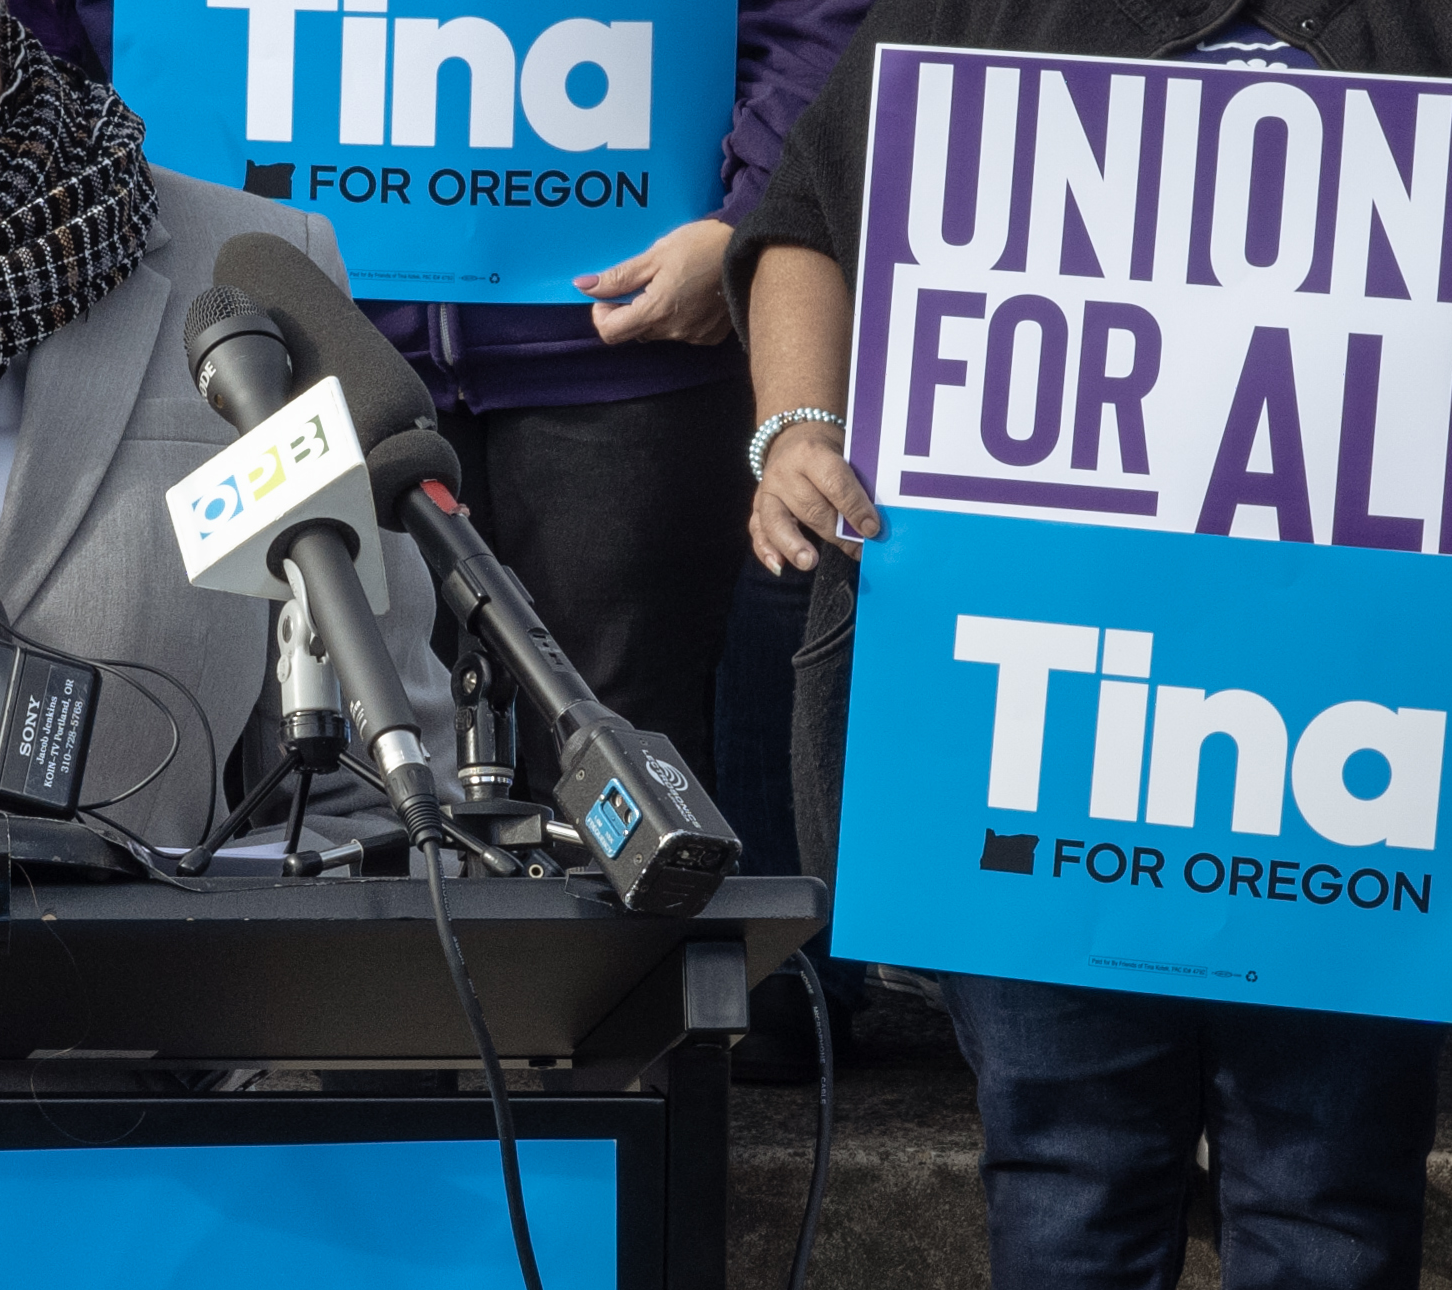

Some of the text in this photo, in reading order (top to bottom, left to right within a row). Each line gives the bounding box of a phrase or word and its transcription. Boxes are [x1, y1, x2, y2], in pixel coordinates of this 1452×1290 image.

[311, 166, 648, 207] FOR OREGON
[904, 287, 1163, 475] FOR
[191, 414, 330, 540] OPB
[19, 695, 41, 757] SONY
[35, 696, 58, 765] Jacob Jenkins
[54, 698, 72, 743] Portland,
[64, 678, 75, 696] OR
[954, 614, 1447, 850] Tina
[641, 749, 702, 830] LECTROSONICS
[1053, 839, 1431, 913] FOR OREGON
